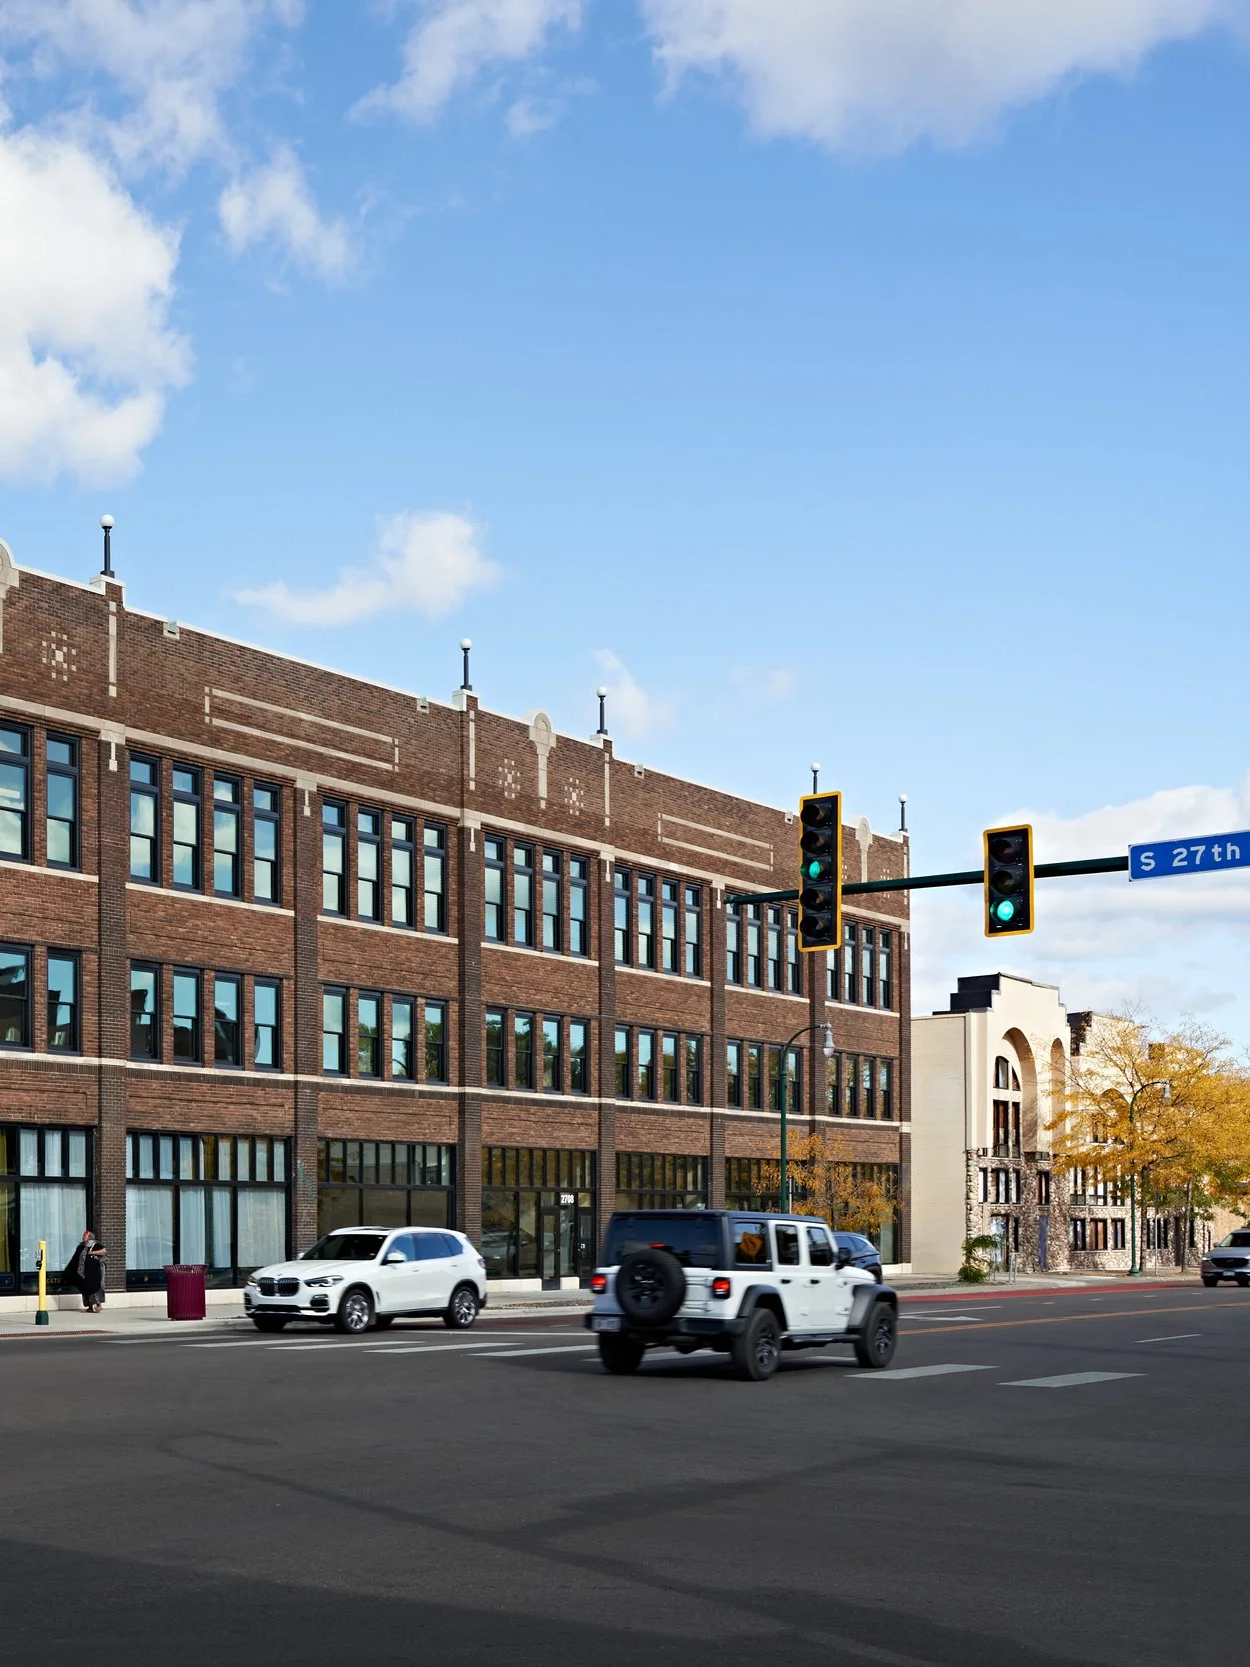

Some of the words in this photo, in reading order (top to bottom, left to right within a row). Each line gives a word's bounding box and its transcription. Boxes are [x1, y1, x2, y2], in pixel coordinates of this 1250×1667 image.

[1140, 852, 1156, 871] S
[1172, 842, 1241, 867] 27th
[560, 1194, 575, 1204] 2708
